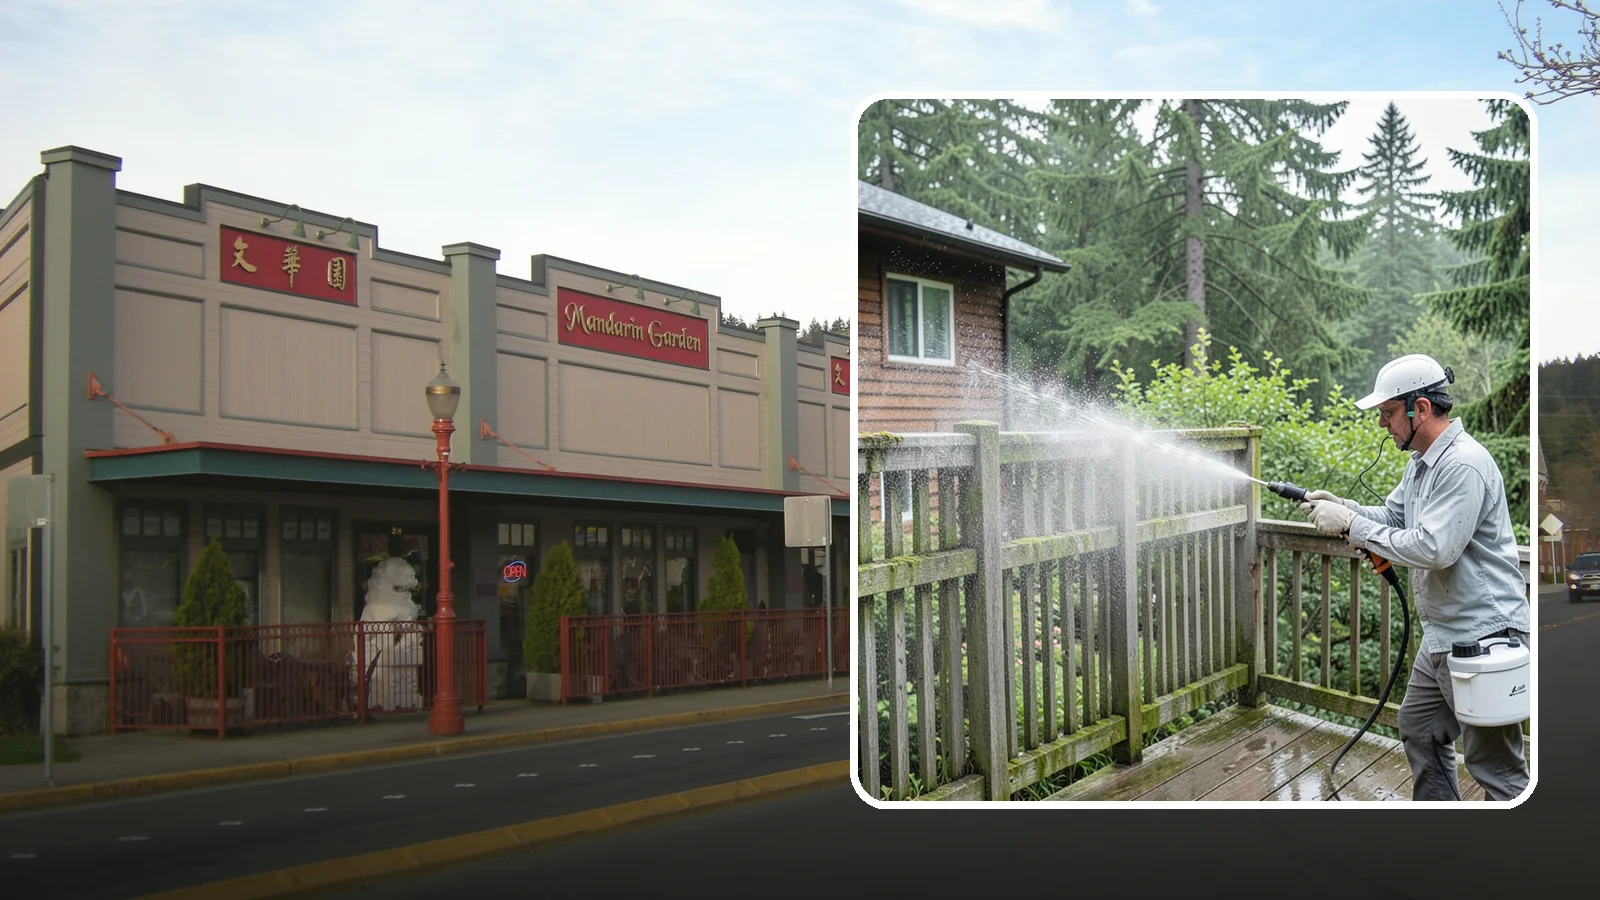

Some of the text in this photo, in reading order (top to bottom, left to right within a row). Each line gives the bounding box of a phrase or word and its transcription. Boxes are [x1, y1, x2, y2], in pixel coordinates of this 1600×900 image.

[231, 235, 346, 291] 文華園
[564, 302, 701, 352] Mandarin Garden
[834, 363, 847, 386] 文
[503, 565, 527, 578] OPEN
